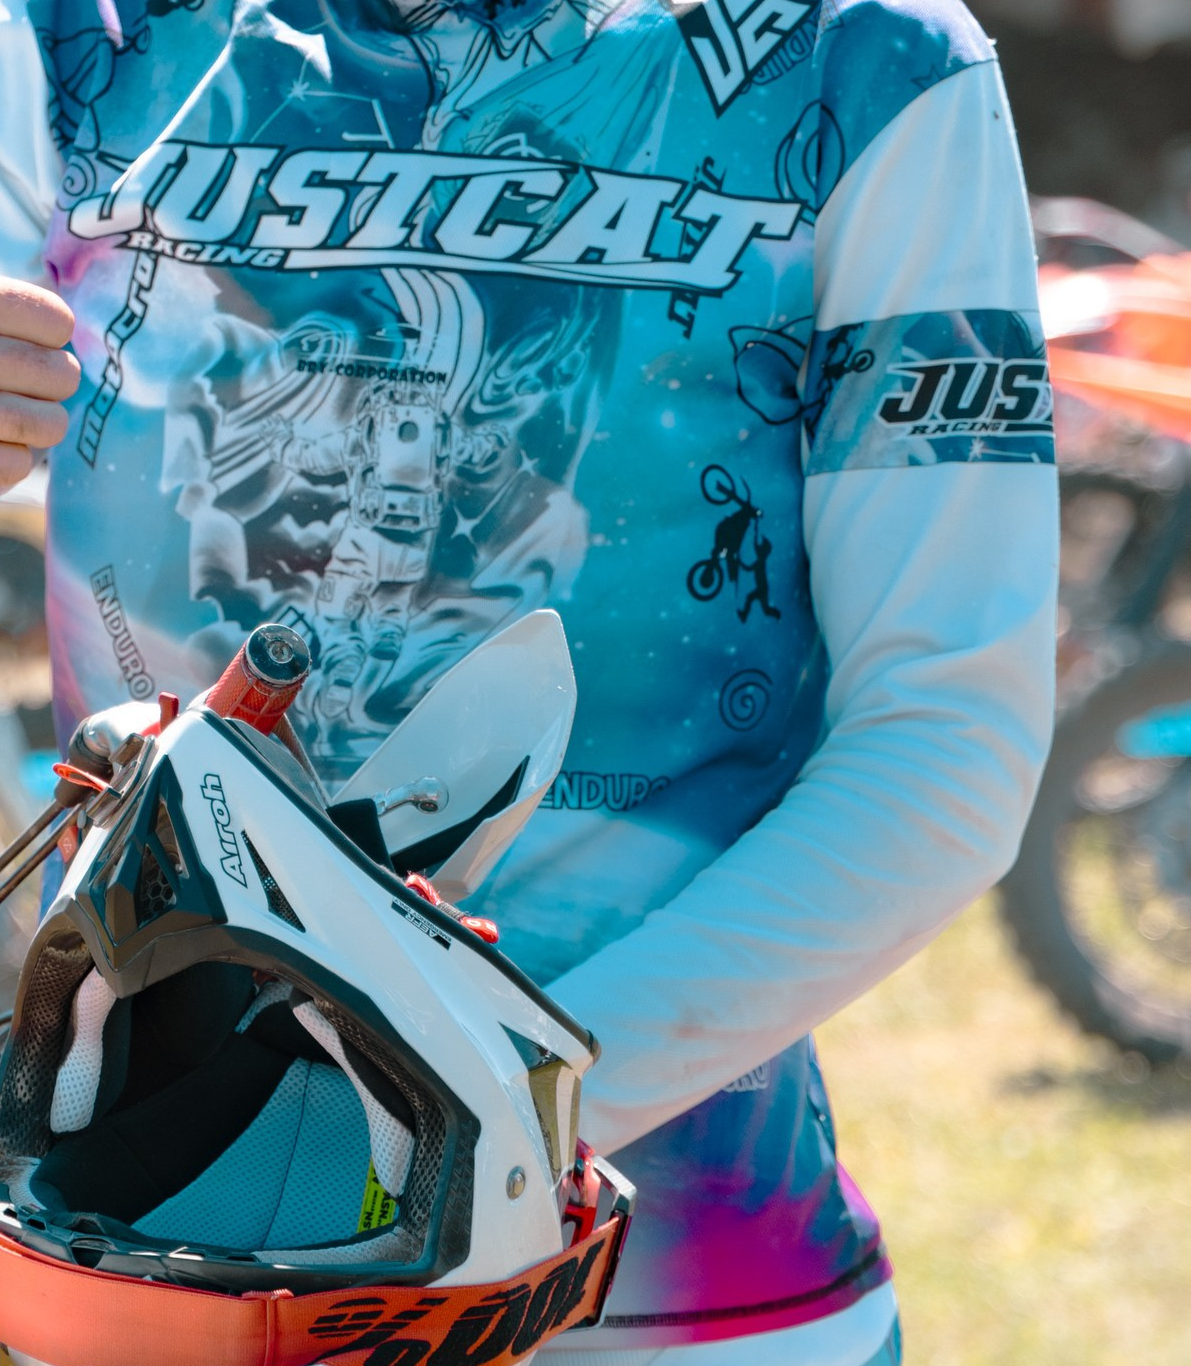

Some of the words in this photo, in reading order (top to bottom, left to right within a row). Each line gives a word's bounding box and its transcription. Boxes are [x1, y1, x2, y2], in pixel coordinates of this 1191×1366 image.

[67, 140, 803, 293] JUSTCAT
[125, 231, 286, 270] RACING
[875, 358, 1052, 425] JUS
[90, 564, 156, 701] ENDURO
